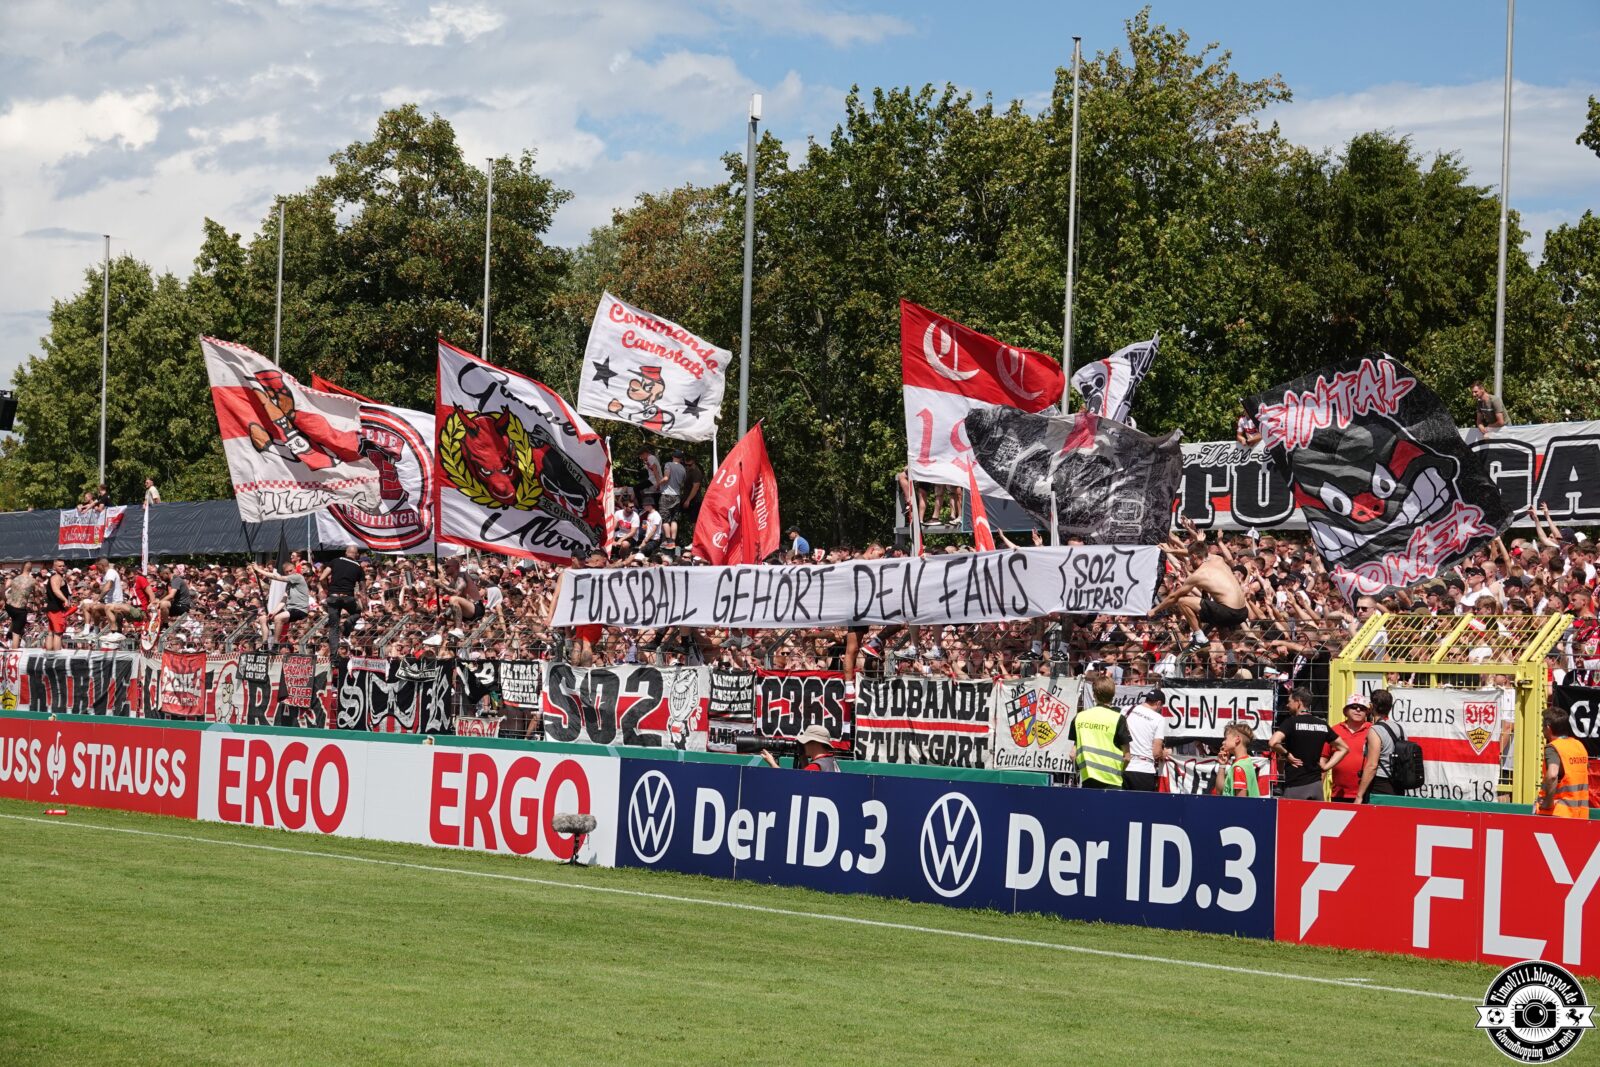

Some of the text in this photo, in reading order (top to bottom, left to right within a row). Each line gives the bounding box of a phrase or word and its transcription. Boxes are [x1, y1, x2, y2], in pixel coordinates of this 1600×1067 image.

[608, 302, 719, 375] Commando
[621, 330, 706, 380] Cannstatt
[1257, 357, 1417, 452] EINTAL
[715, 468, 737, 488] 19
[344, 504, 421, 528] REUTLINGEN
[1329, 499, 1497, 606] POWER
[570, 551, 1028, 627] FUSSBALL GEHÖRT DEN FANS
[1066, 586, 1124, 611] ULTRAS
[1077, 721, 1110, 732] SECURITY
[1168, 694, 1218, 730] SLN
[1390, 698, 1456, 725] Glems
[1464, 703, 1497, 726] VfB
[71, 740, 187, 800] STRAUSS
[855, 731, 989, 770] STUTTGART
[996, 747, 1074, 772] Gundelsheim
[217, 737, 350, 834] ERGO
[429, 751, 592, 860] ERGO
[692, 787, 888, 875] Der ID.3
[1005, 812, 1257, 913] Der ID.3
